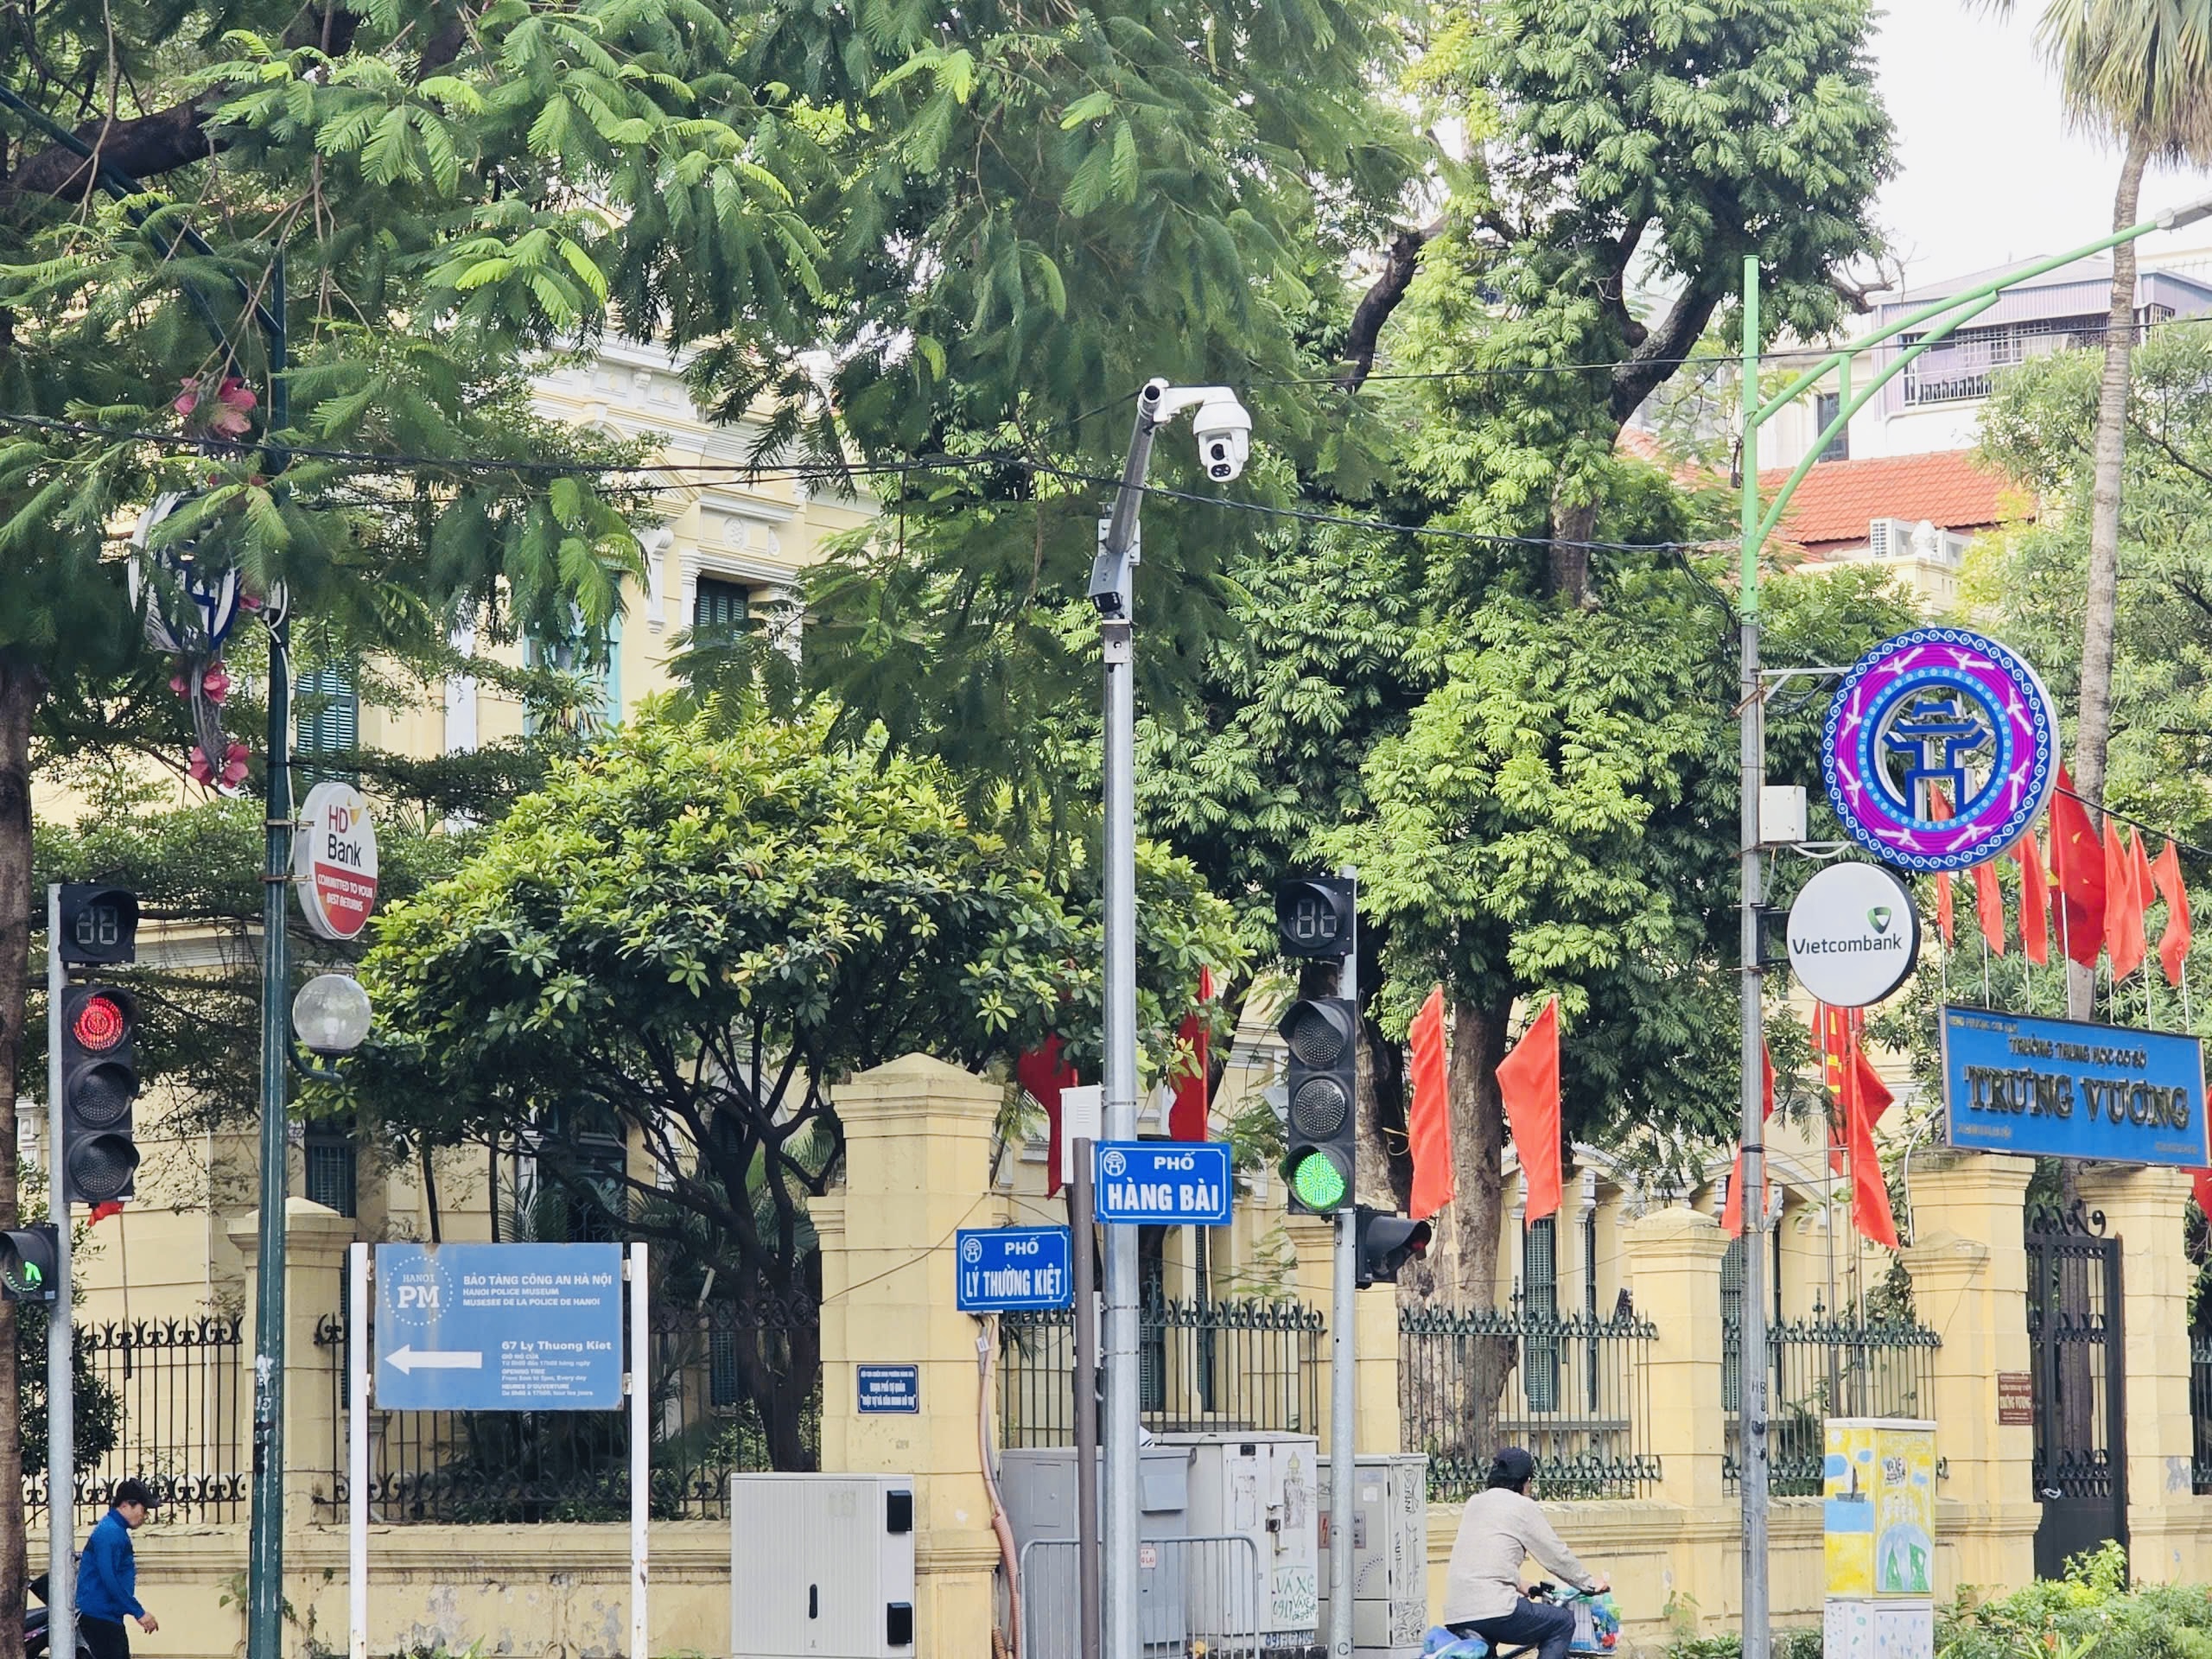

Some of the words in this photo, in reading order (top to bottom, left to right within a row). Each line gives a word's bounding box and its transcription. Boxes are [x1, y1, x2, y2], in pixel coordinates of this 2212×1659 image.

[329, 804, 348, 834] HD
[327, 833, 362, 868] Bank
[317, 874, 349, 892] COMMITTED
[349, 881, 358, 894] TO
[1792, 933, 1903, 955] Vietcombank
[2009, 1033, 2053, 1058] TRƯỜNG
[2055, 1042, 2090, 1063] TRUNG
[2091, 1046, 2113, 1068] HỌC
[1964, 1065, 2074, 1118] TRƯNG
[2080, 1077, 2190, 1129] VƯƠNG
[1153, 1151, 1195, 1171] PHỐ
[1107, 1176, 1173, 1211] HÀNG
[1179, 1178, 1218, 1211] BÀI
[1004, 1236, 1040, 1255] PHỐ
[403, 1274, 435, 1282] HANOI
[463, 1272, 486, 1286] BẢO
[488, 1273, 518, 1285] TÀNG
[521, 1273, 553, 1285] CÔNG
[555, 1275, 571, 1285] AN
[574, 1272, 589, 1285] HÀ
[592, 1272, 612, 1287] NỘI
[966, 1265, 979, 1298] LÝ
[982, 1264, 1031, 1296] THƯỜNG
[1034, 1262, 1062, 1300] KIỆT
[397, 1285, 440, 1308] PM
[501, 1341, 518, 1351] 67
[520, 1341, 534, 1352] Ly
[537, 1341, 583, 1353] Thuong
[586, 1341, 612, 1351] Kiet
